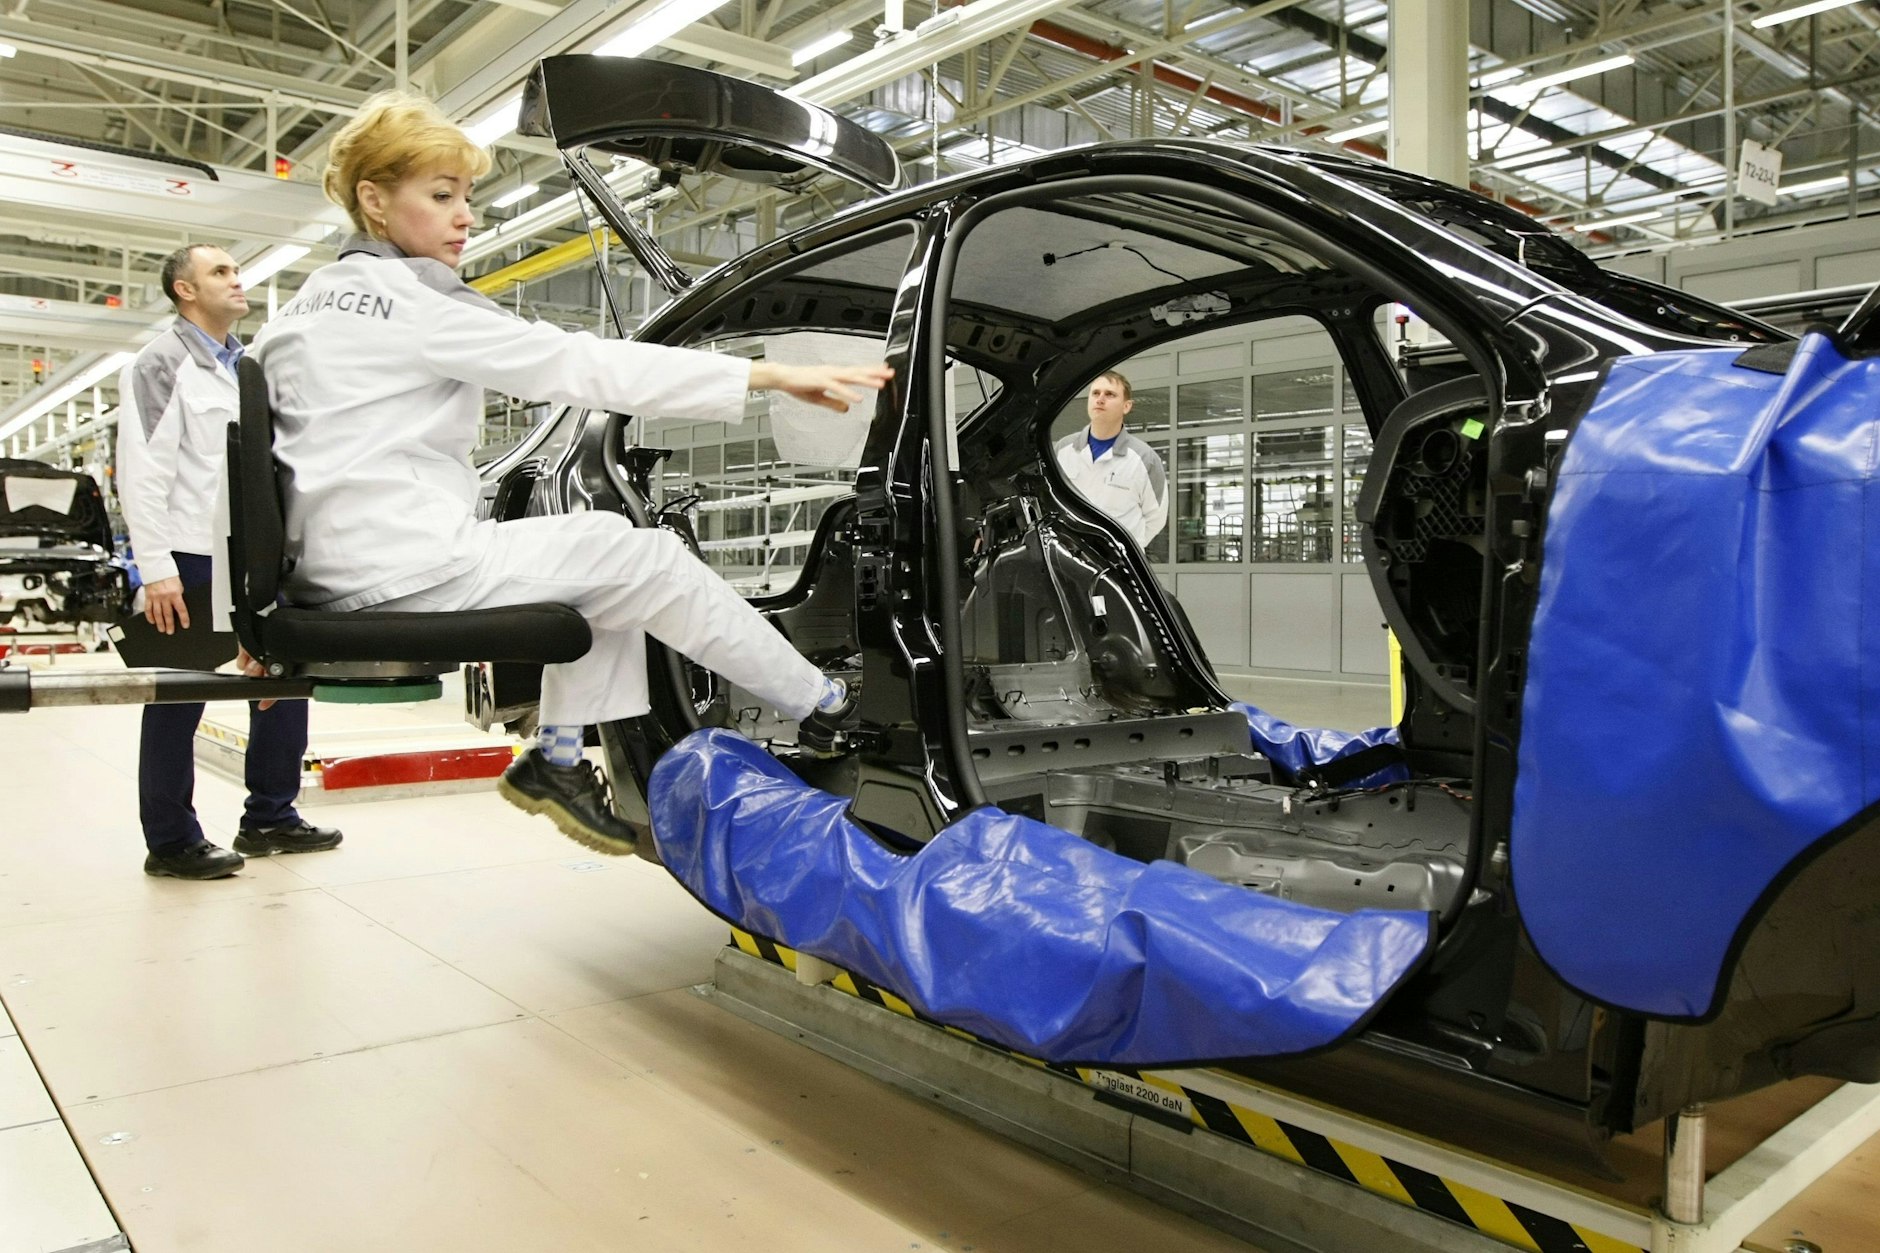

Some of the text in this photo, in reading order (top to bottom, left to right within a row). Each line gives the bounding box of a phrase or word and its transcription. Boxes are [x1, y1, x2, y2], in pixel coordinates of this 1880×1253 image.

[162, 178, 191, 195] 3
[283, 290, 393, 319] KSWAGEN
[1136, 1086, 1160, 1103] 2200
[1162, 1097, 1182, 1112] daN
